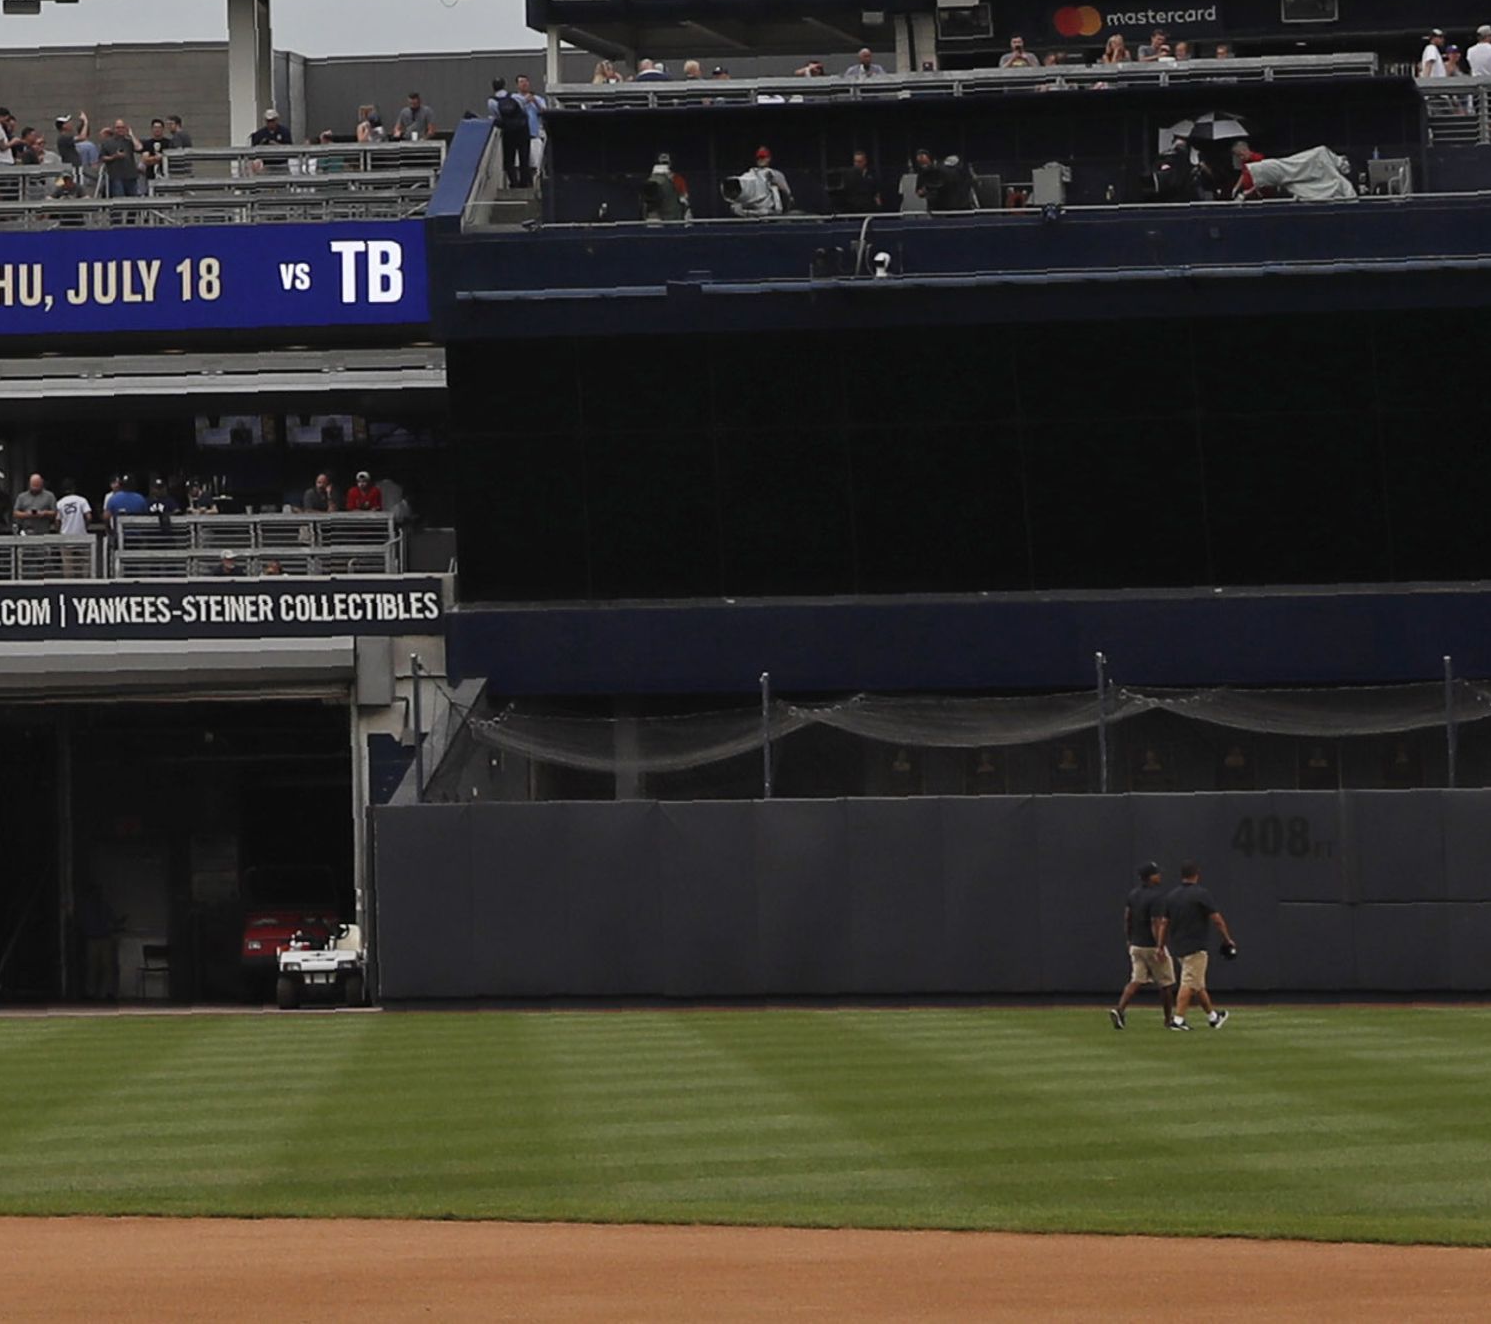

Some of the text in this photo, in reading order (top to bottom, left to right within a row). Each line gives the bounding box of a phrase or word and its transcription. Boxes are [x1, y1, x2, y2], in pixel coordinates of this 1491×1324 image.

[1107, 6, 1216, 26] mastercard
[67, 260, 160, 304] JULY
[177, 258, 220, 301] 18
[331, 241, 402, 302] TB
[73, 595, 273, 623] YANKEES-STEINER
[280, 593, 438, 621] COLLECTIBLES
